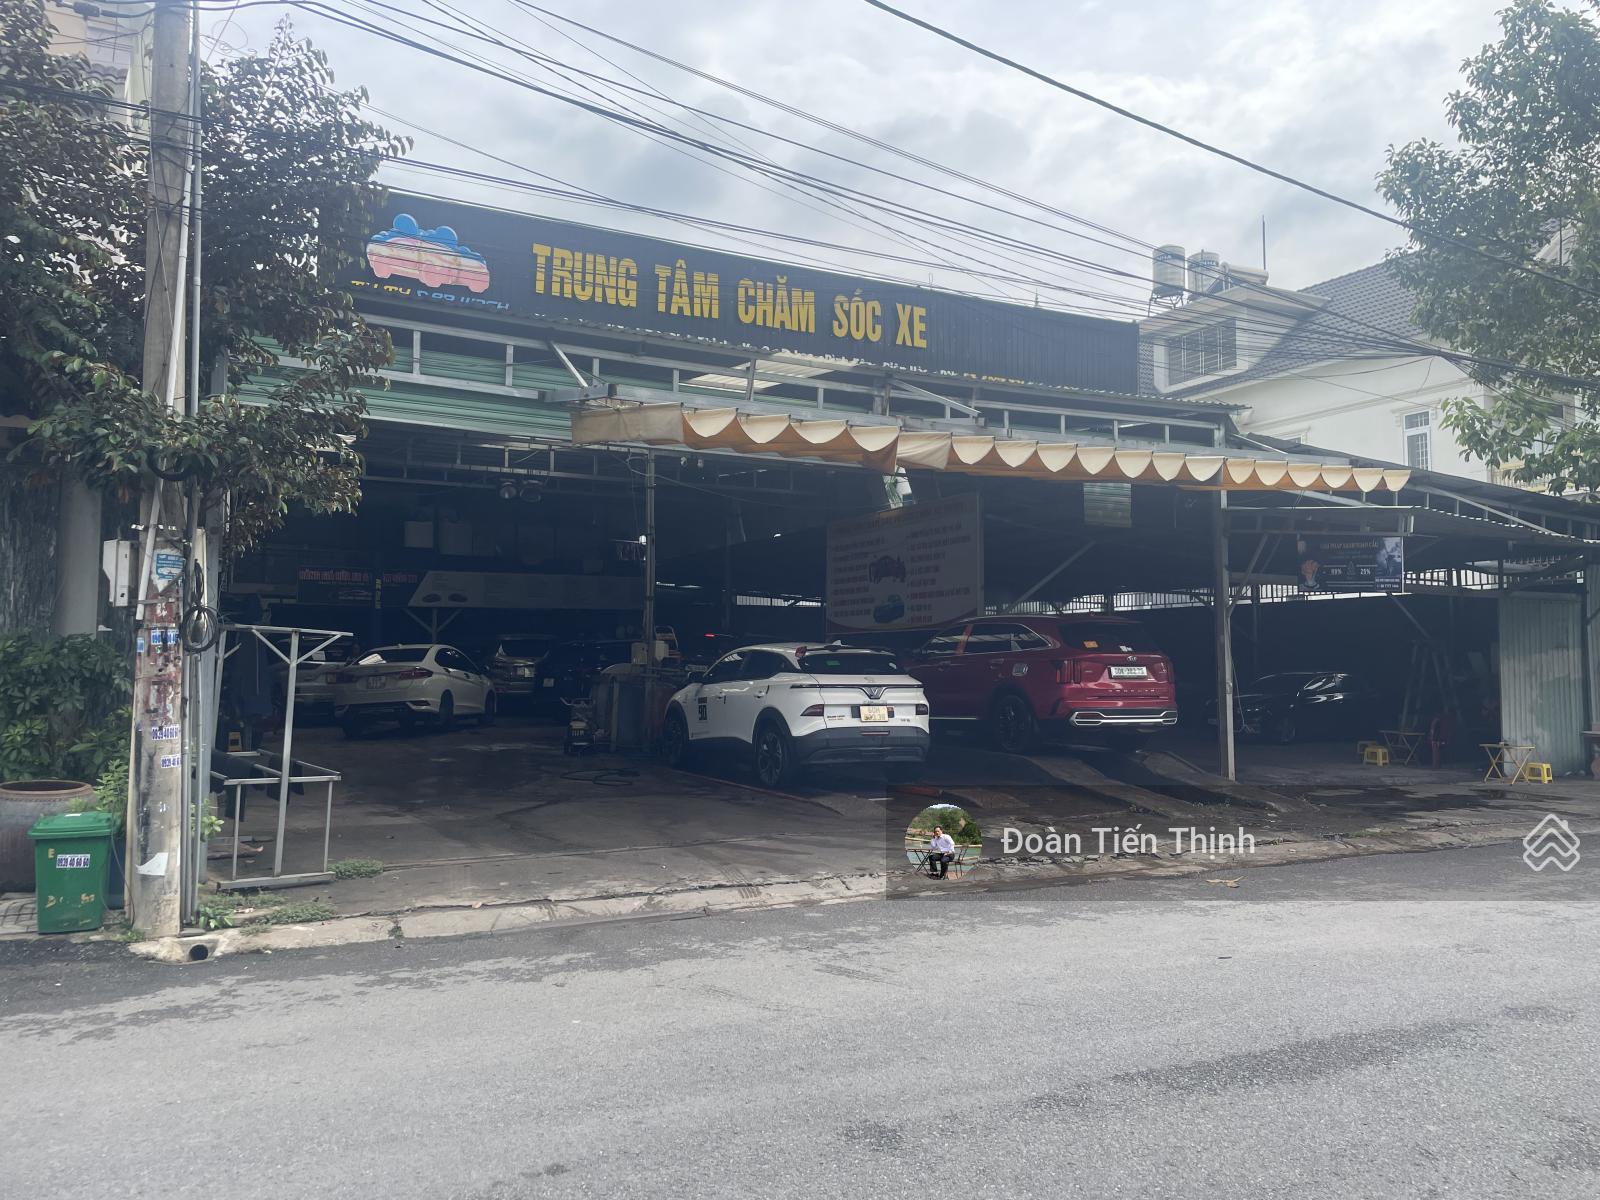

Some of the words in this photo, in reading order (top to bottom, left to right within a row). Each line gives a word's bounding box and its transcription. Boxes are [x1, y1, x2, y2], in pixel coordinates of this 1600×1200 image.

[533, 243, 638, 308] TRUNG
[655, 258, 719, 320] TÂM
[738, 275, 816, 334] CHĂM
[833, 288, 882, 342] SÓC
[896, 303, 927, 349] XE
